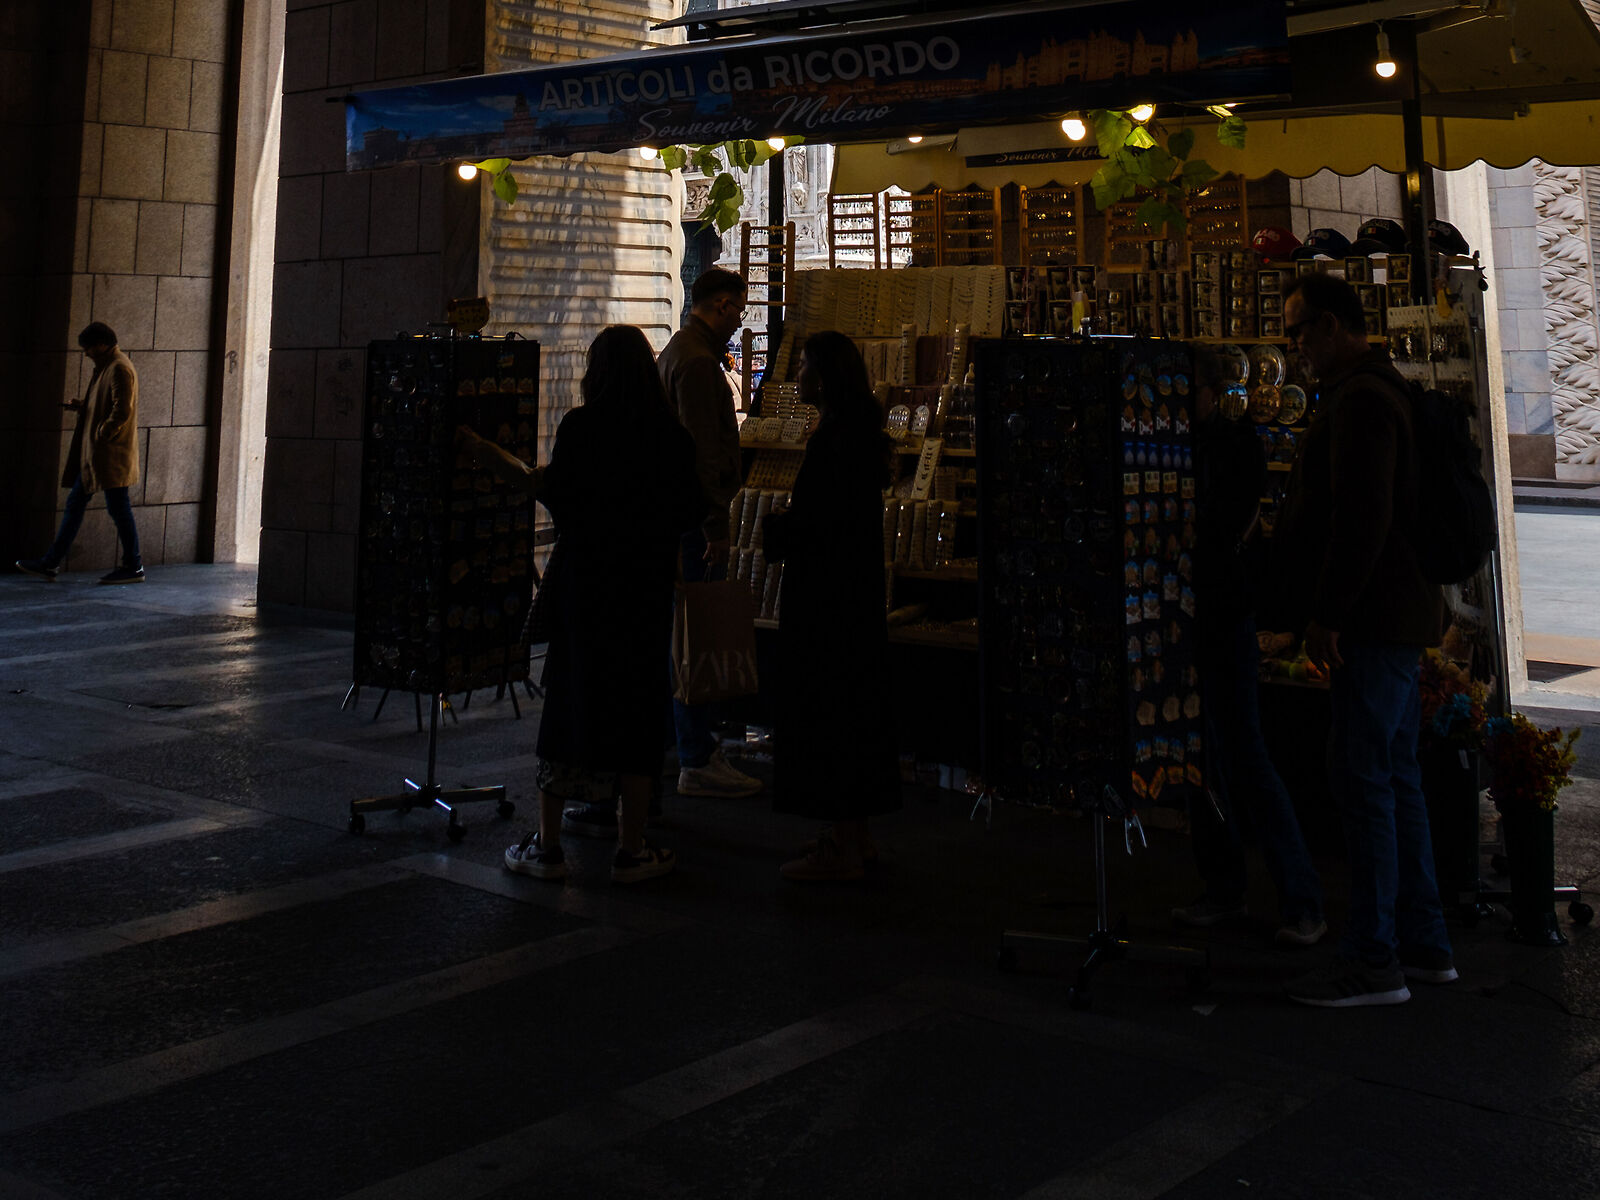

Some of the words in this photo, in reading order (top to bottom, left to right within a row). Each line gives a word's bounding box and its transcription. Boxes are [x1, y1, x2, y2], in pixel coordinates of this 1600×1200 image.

[539, 63, 695, 113] ARTICOLI
[706, 60, 755, 95] da
[763, 35, 961, 90] RICORDO
[632, 108, 759, 144] Souvenir
[772, 95, 894, 131] Milano
[995, 151, 1057, 164] Souvenir
